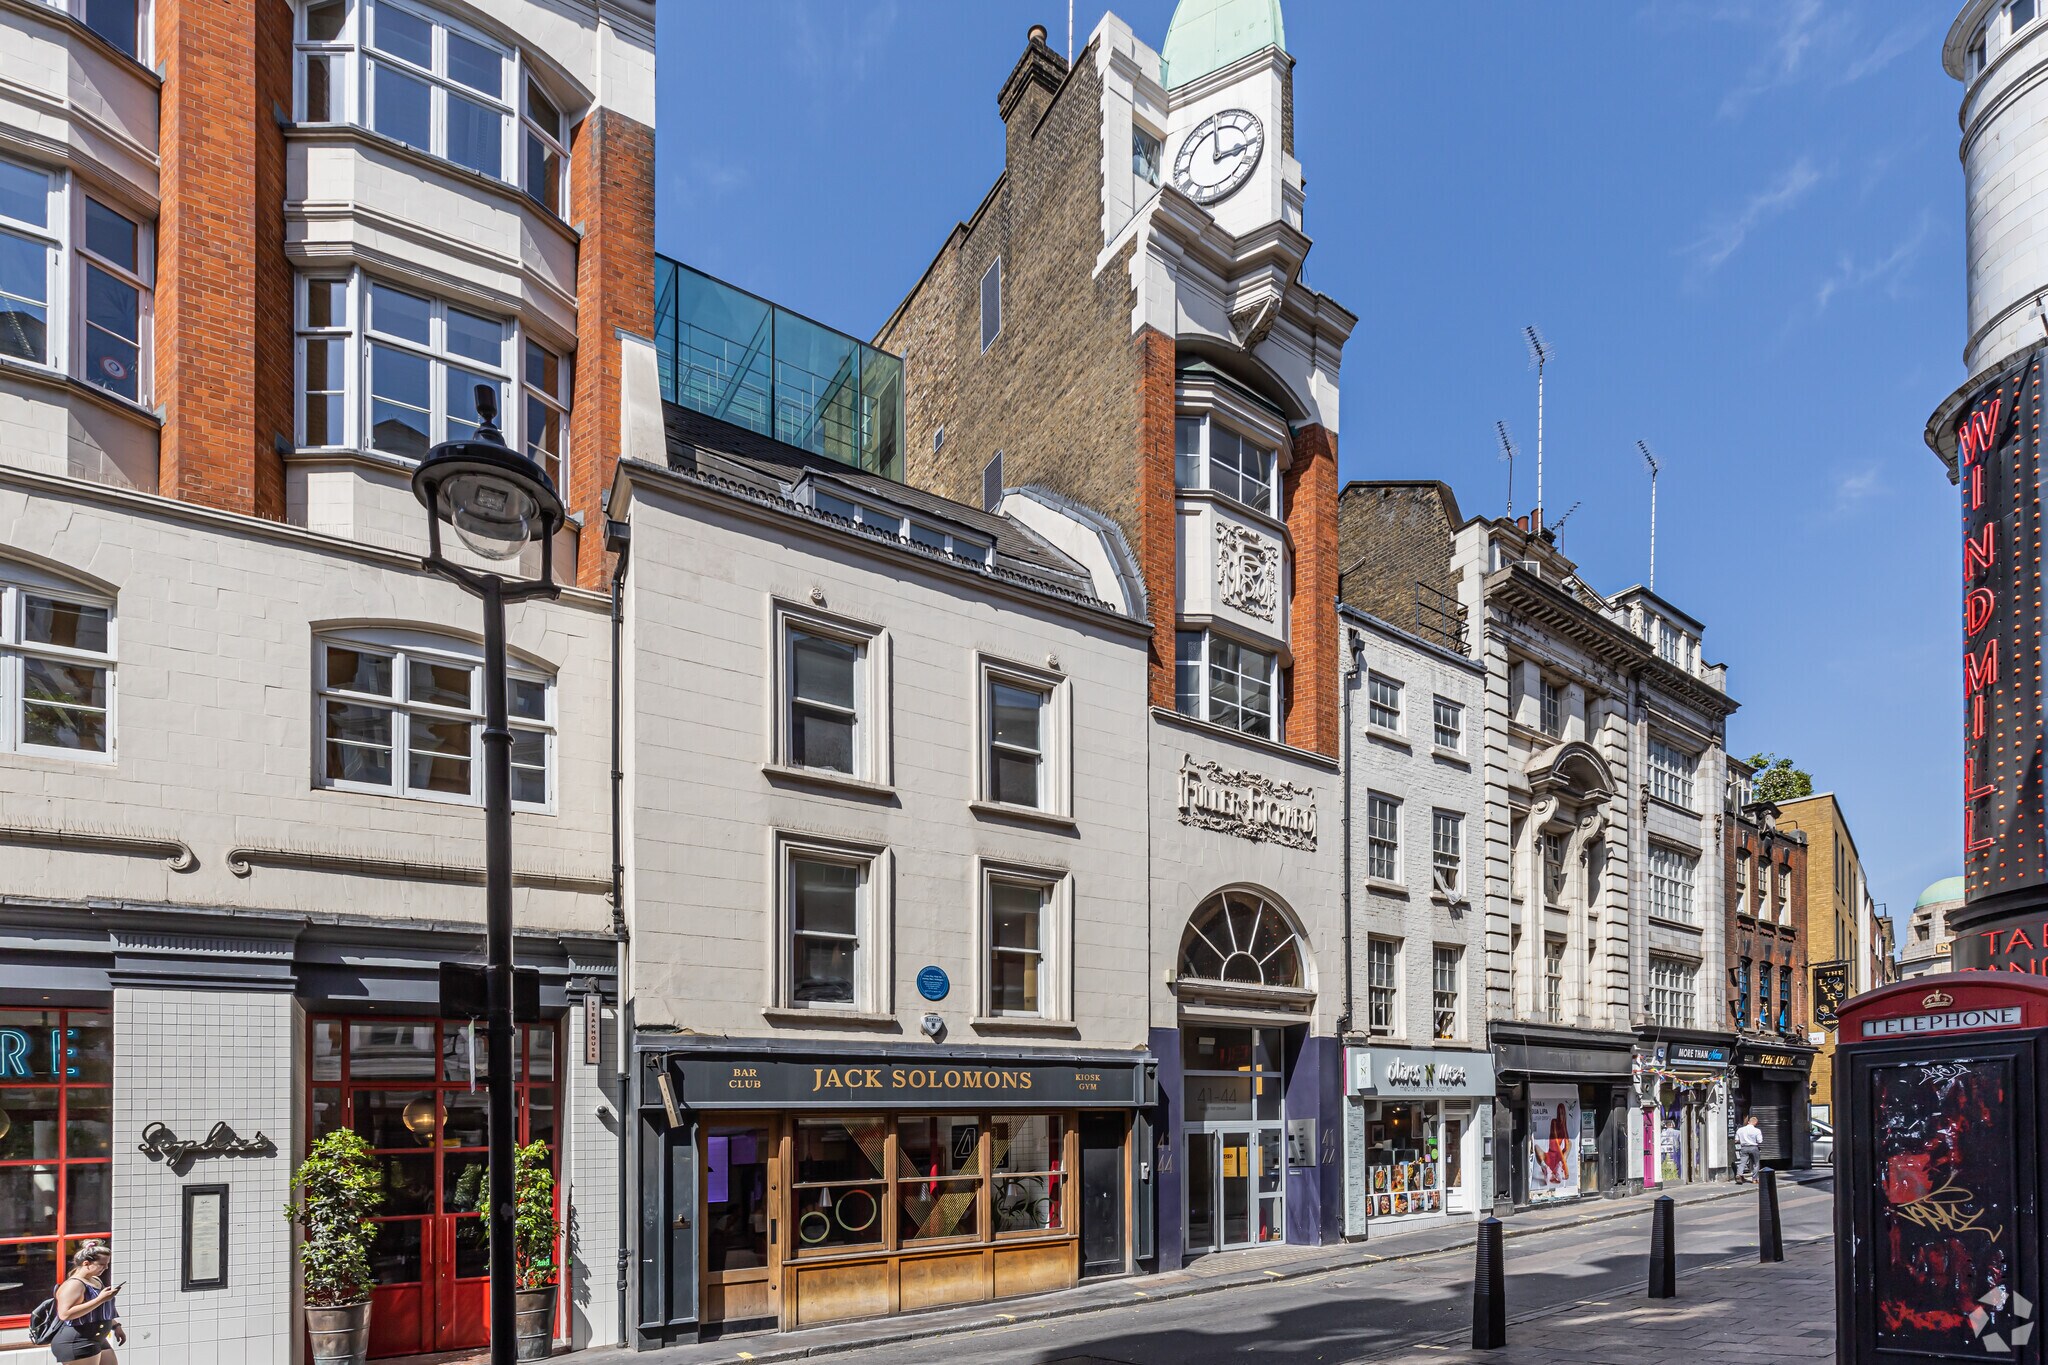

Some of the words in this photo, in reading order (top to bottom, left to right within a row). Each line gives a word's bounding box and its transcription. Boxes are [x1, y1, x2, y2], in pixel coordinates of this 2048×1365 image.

[1959, 398, 2000, 852] WINDMILL
[1825, 969, 1844, 977] THE
[1818, 978, 1840, 1014] LYRI
[1867, 1008, 2014, 1035] TELEPHONE
[1678, 1048, 1694, 1058] MORE
[1694, 1049, 1709, 1059] THAN
[733, 1068, 757, 1077] BAR
[1075, 1073, 1101, 1081] KIOSK
[729, 1080, 761, 1088] CLUB
[812, 1068, 883, 1092] JACK
[892, 1069, 1033, 1089] SOLOMONS
